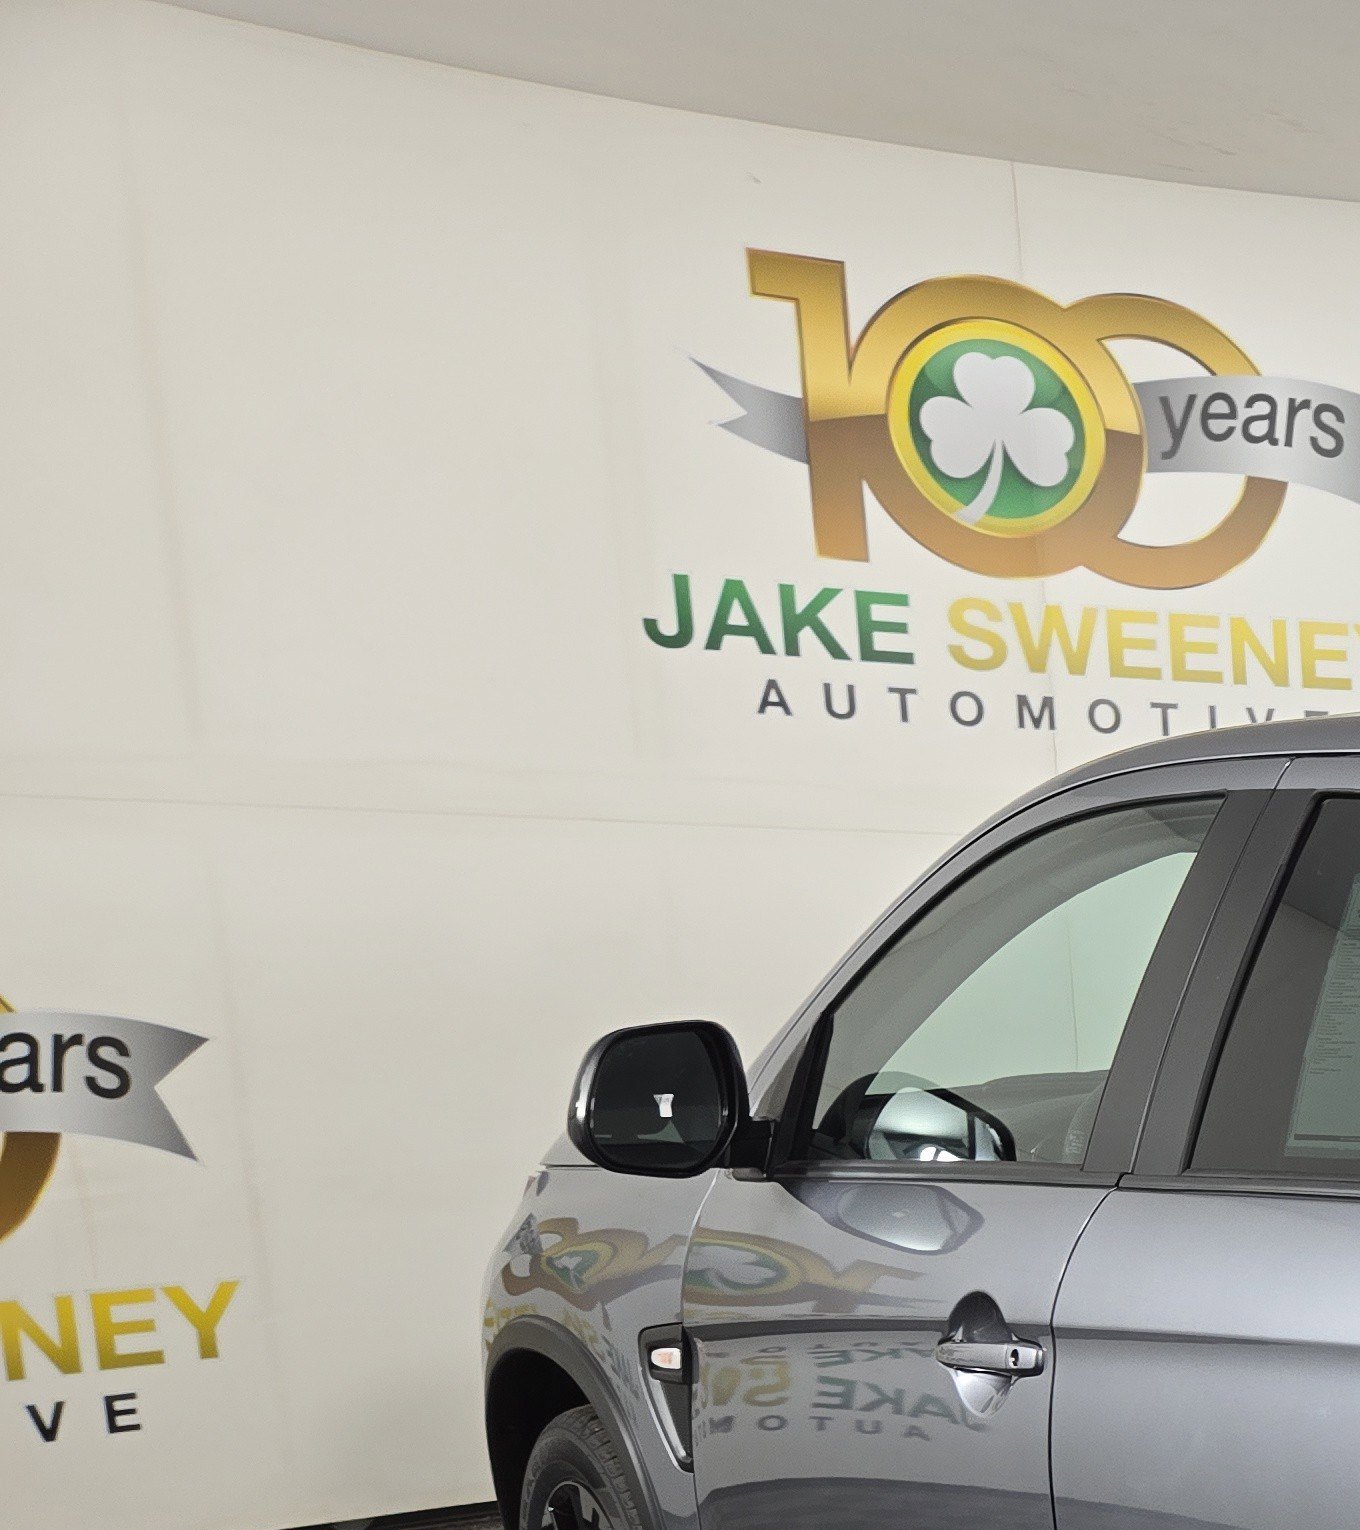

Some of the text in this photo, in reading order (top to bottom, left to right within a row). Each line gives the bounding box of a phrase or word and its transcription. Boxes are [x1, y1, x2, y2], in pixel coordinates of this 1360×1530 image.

[1160, 391, 1346, 460] years
[642, 573, 915, 666] JAKE
[757, 678, 1329, 737] AUTOMOTI
